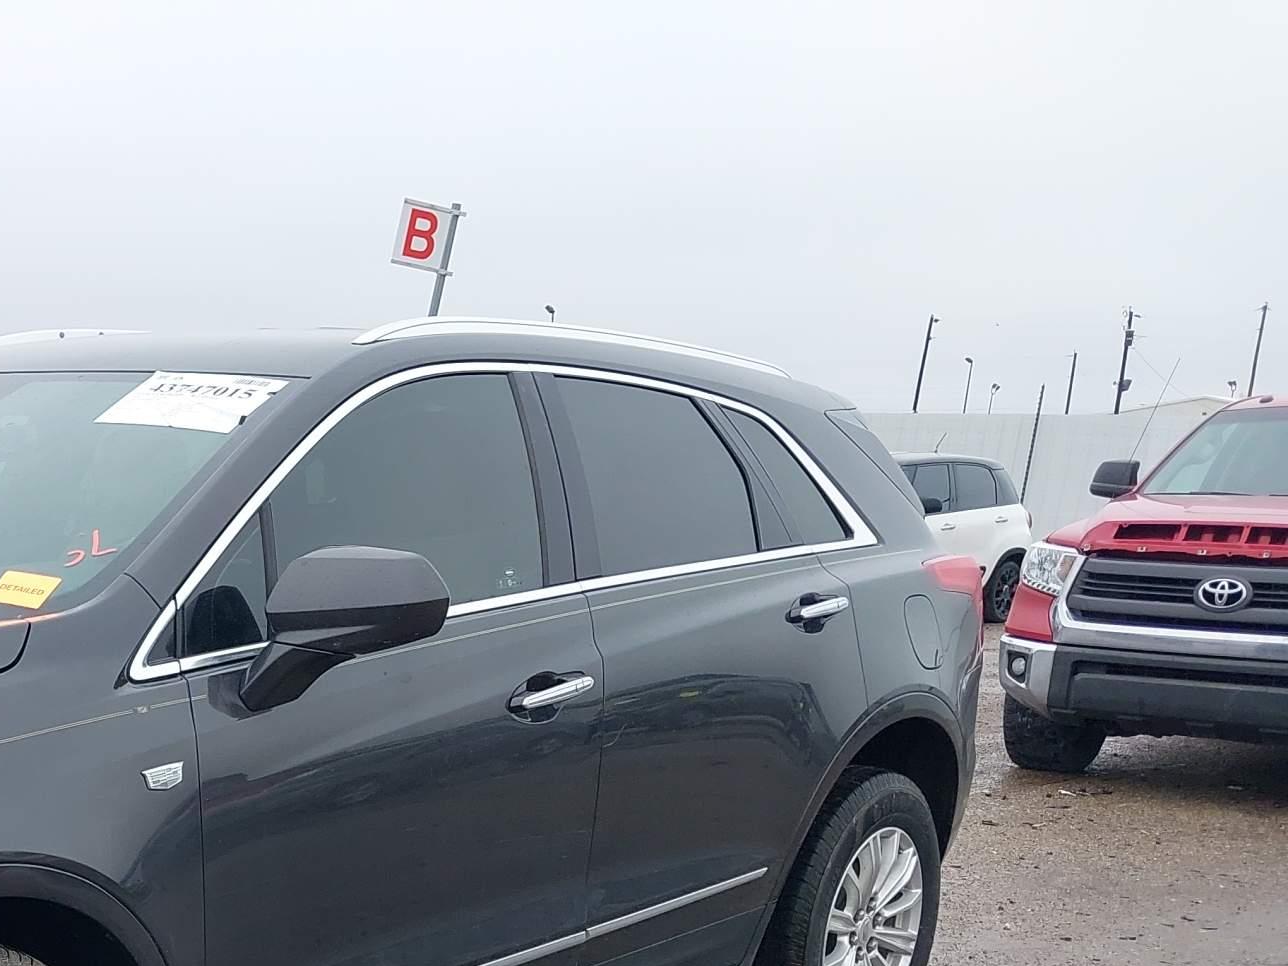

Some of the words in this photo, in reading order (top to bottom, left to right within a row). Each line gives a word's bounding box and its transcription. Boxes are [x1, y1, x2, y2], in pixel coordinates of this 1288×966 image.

[402, 208, 439, 260] B
[149, 383, 259, 399] 43747015
[0, 583, 45, 596] DETAILED
